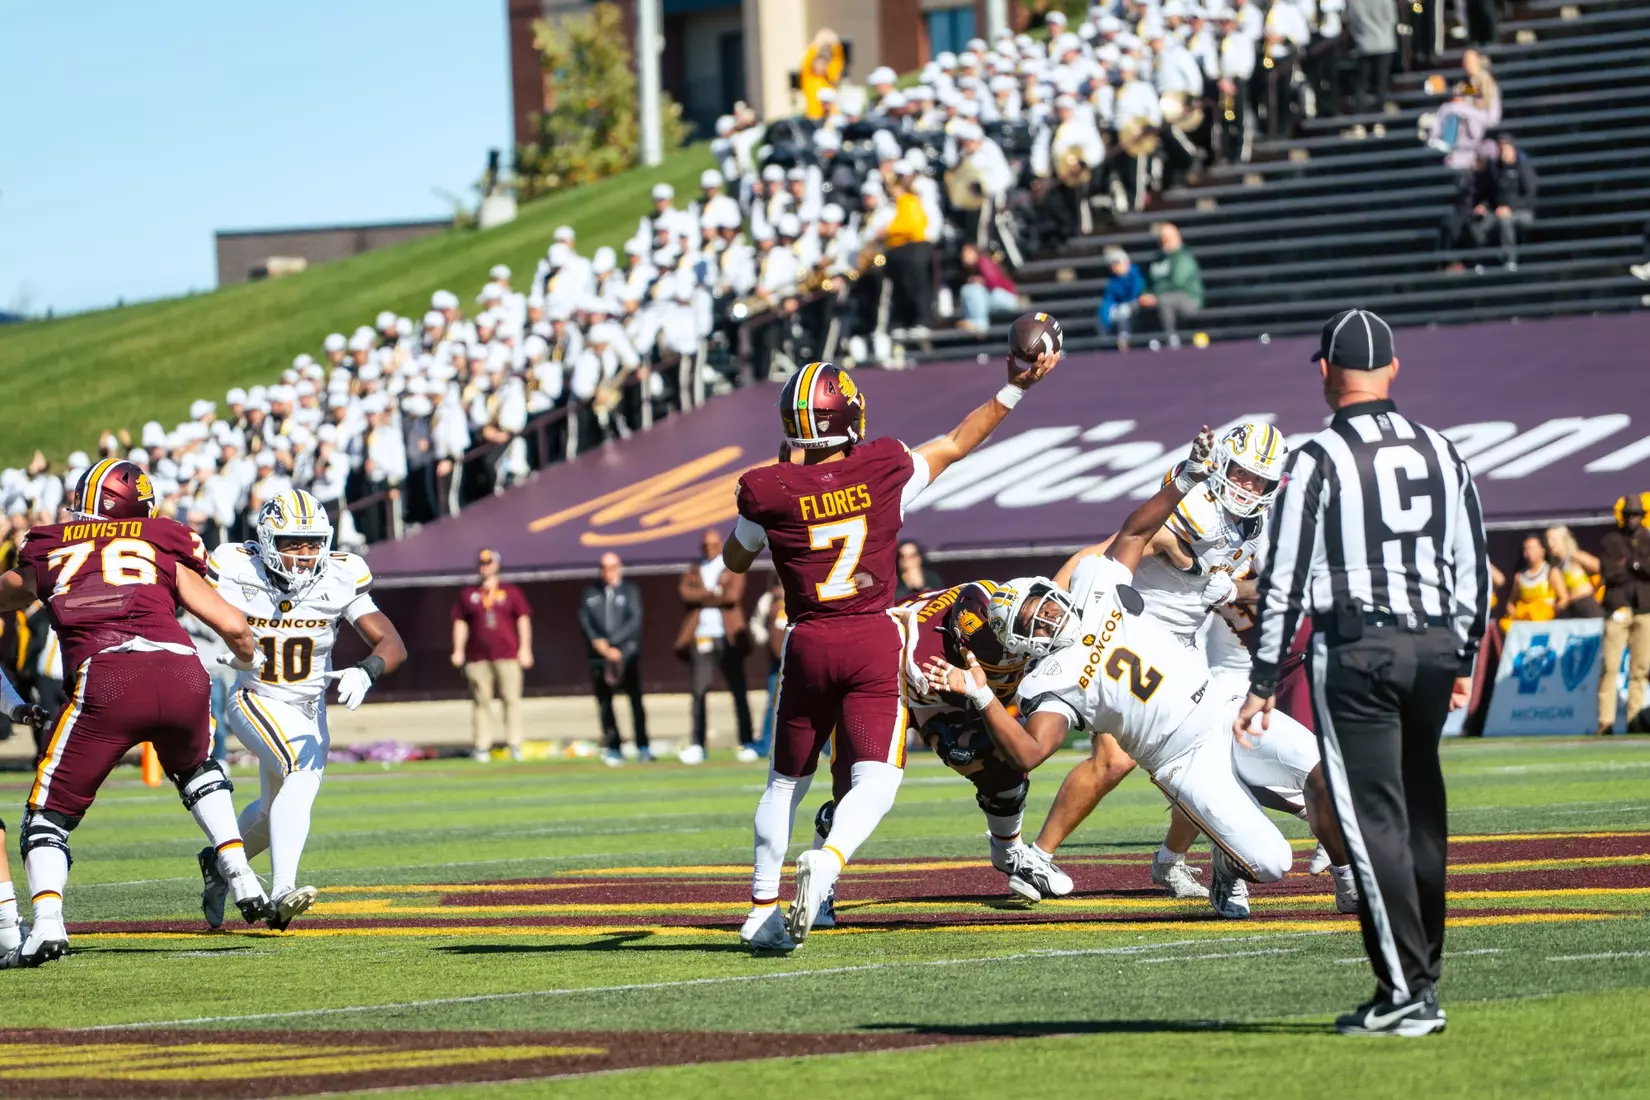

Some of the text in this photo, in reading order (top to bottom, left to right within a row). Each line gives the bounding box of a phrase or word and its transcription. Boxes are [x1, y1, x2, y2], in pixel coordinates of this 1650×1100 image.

[799, 483, 872, 520] FLORES
[1373, 445, 1432, 533] C
[62, 521, 142, 542] KOIVISTO
[808, 514, 868, 602] 7
[47, 537, 157, 603] 76
[246, 616, 328, 628] BRONCOS
[1079, 609, 1123, 691] BRONCOS
[258, 636, 314, 684] 10
[1105, 647, 1164, 704] 2
